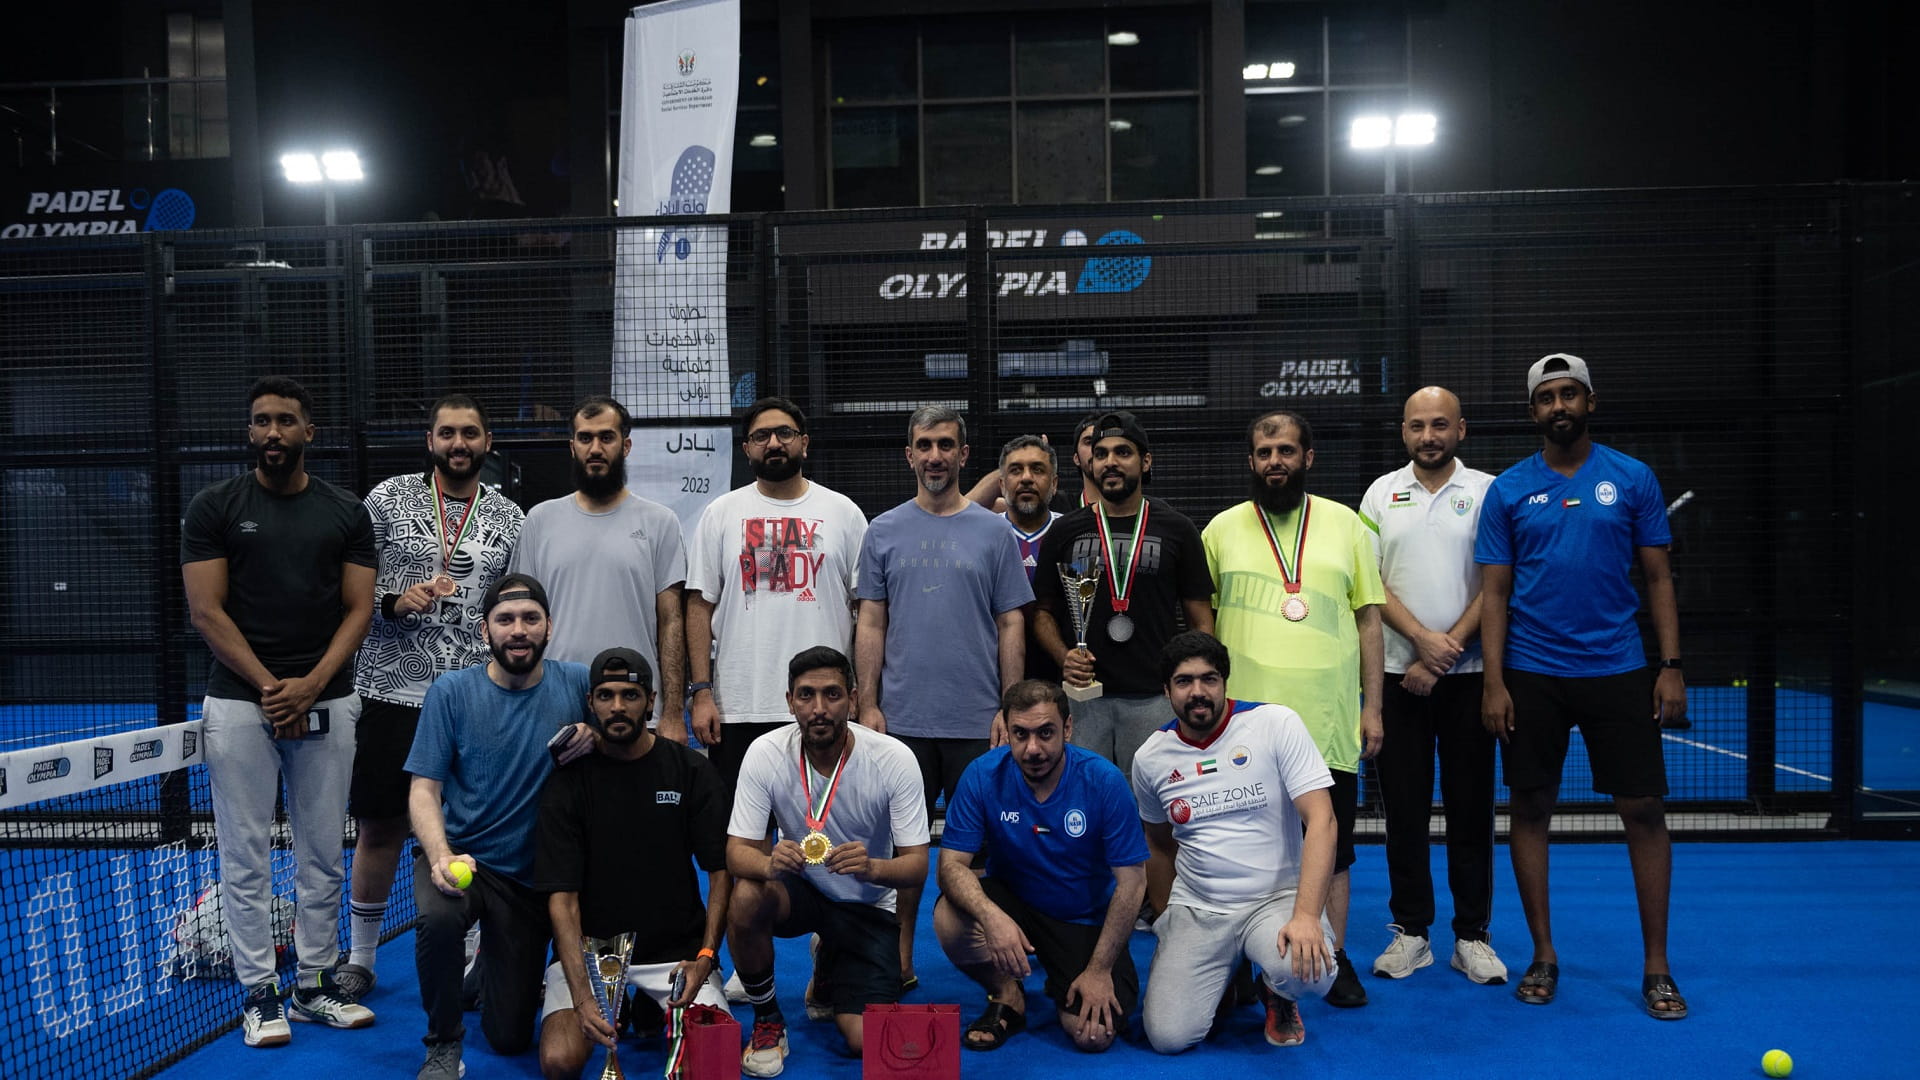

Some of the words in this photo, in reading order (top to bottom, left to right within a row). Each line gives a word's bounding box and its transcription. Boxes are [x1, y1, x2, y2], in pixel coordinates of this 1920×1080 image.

[27, 189, 125, 214] PADEL
[879, 271, 1068, 300] OLYPIA
[662, 354, 712, 376] جتماعية
[1280, 359, 1352, 378] PADEL
[1260, 378, 1360, 397] OLYMPIA
[681, 477, 710, 494] 2023
[748, 518, 818, 549] STAY
[921, 540, 958, 550] NIKE
[901, 558, 973, 569] RUNNING
[453, 585, 473, 599] &T
[28, 769, 57, 783] OLYMPIA
[34, 761, 54, 773] PADEL
[1191, 792, 1219, 809] SAIF
[1222, 782, 1265, 803] ZONE
